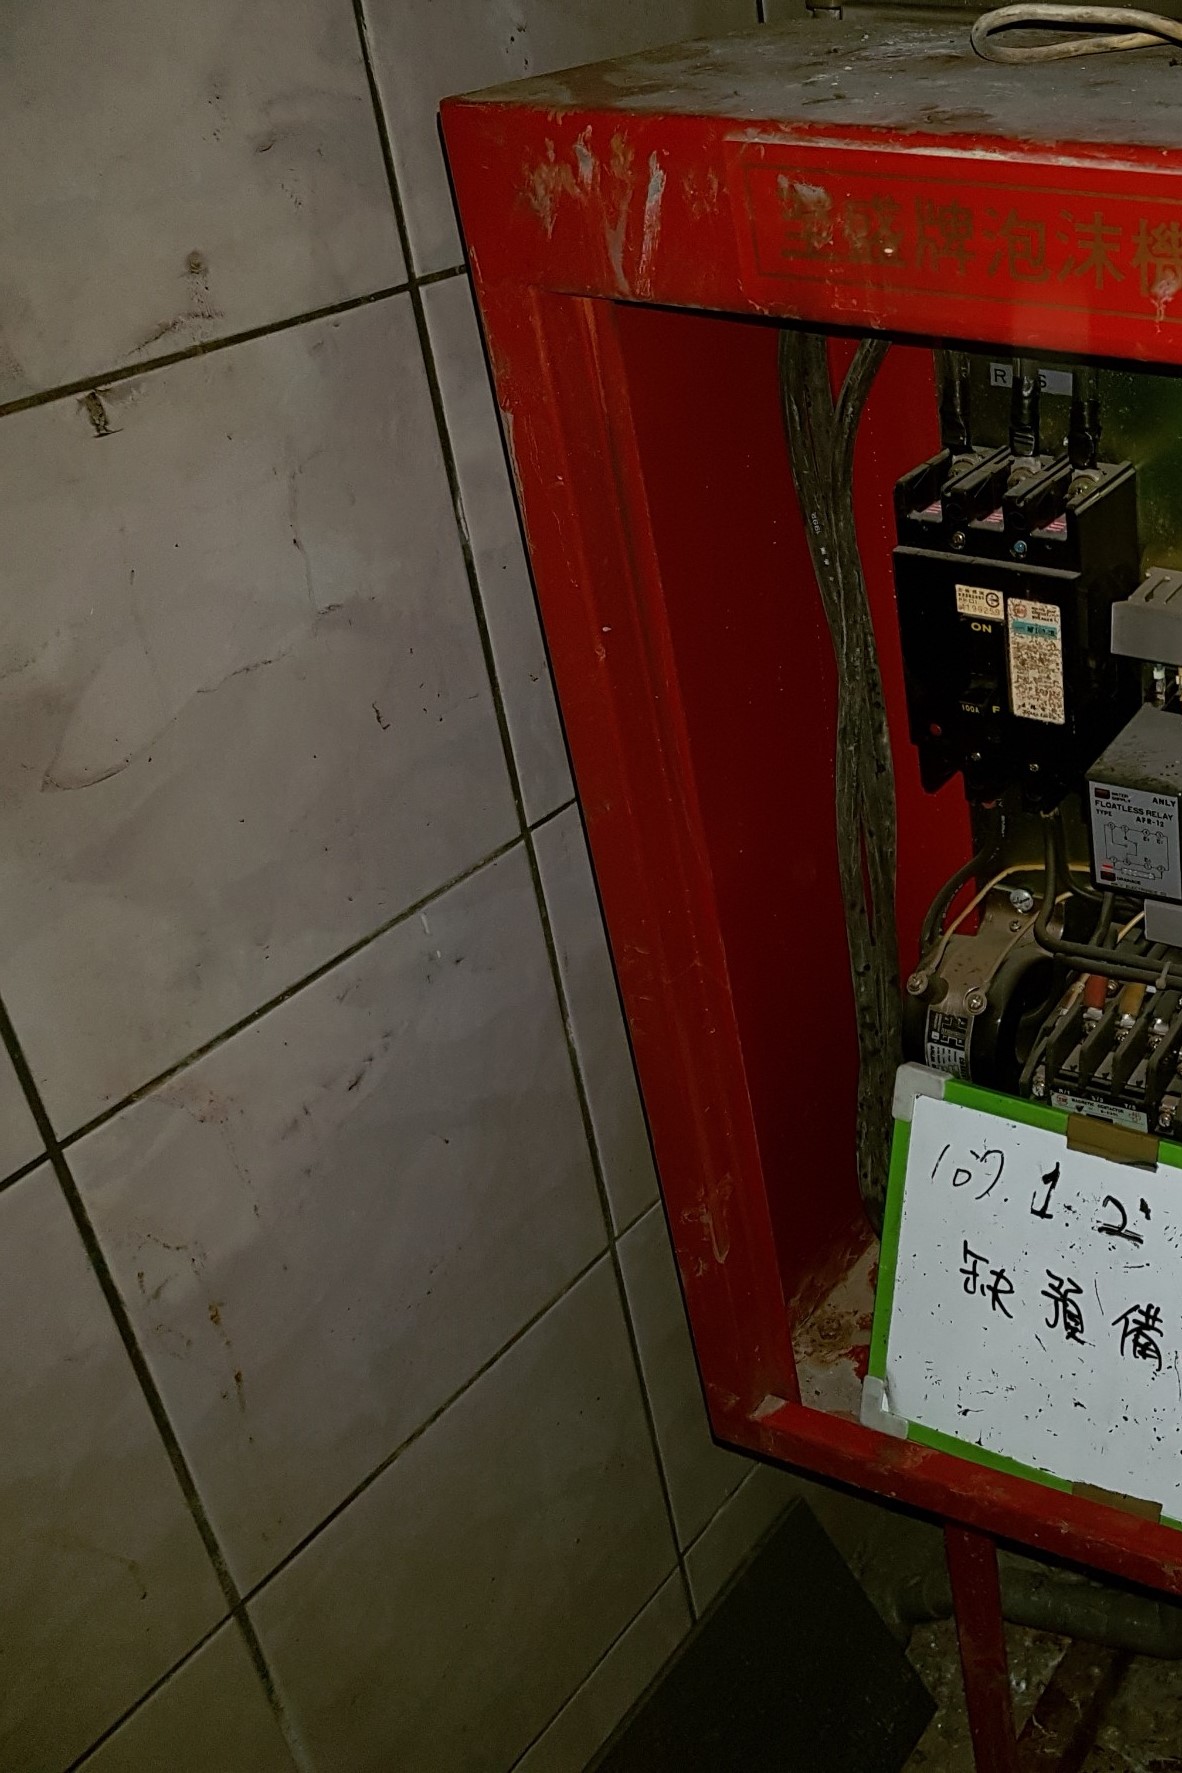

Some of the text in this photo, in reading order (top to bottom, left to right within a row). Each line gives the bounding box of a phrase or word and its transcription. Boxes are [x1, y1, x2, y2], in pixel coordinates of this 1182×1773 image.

[993, 368, 1007, 384] R
[970, 622, 992, 633] ON
[962, 703, 980, 714] 100A
[1152, 797, 1176, 808] ANLY
[1094, 799, 1174, 821] FLOATLESS RELAY
[1095, 808, 1113, 817] TYPE
